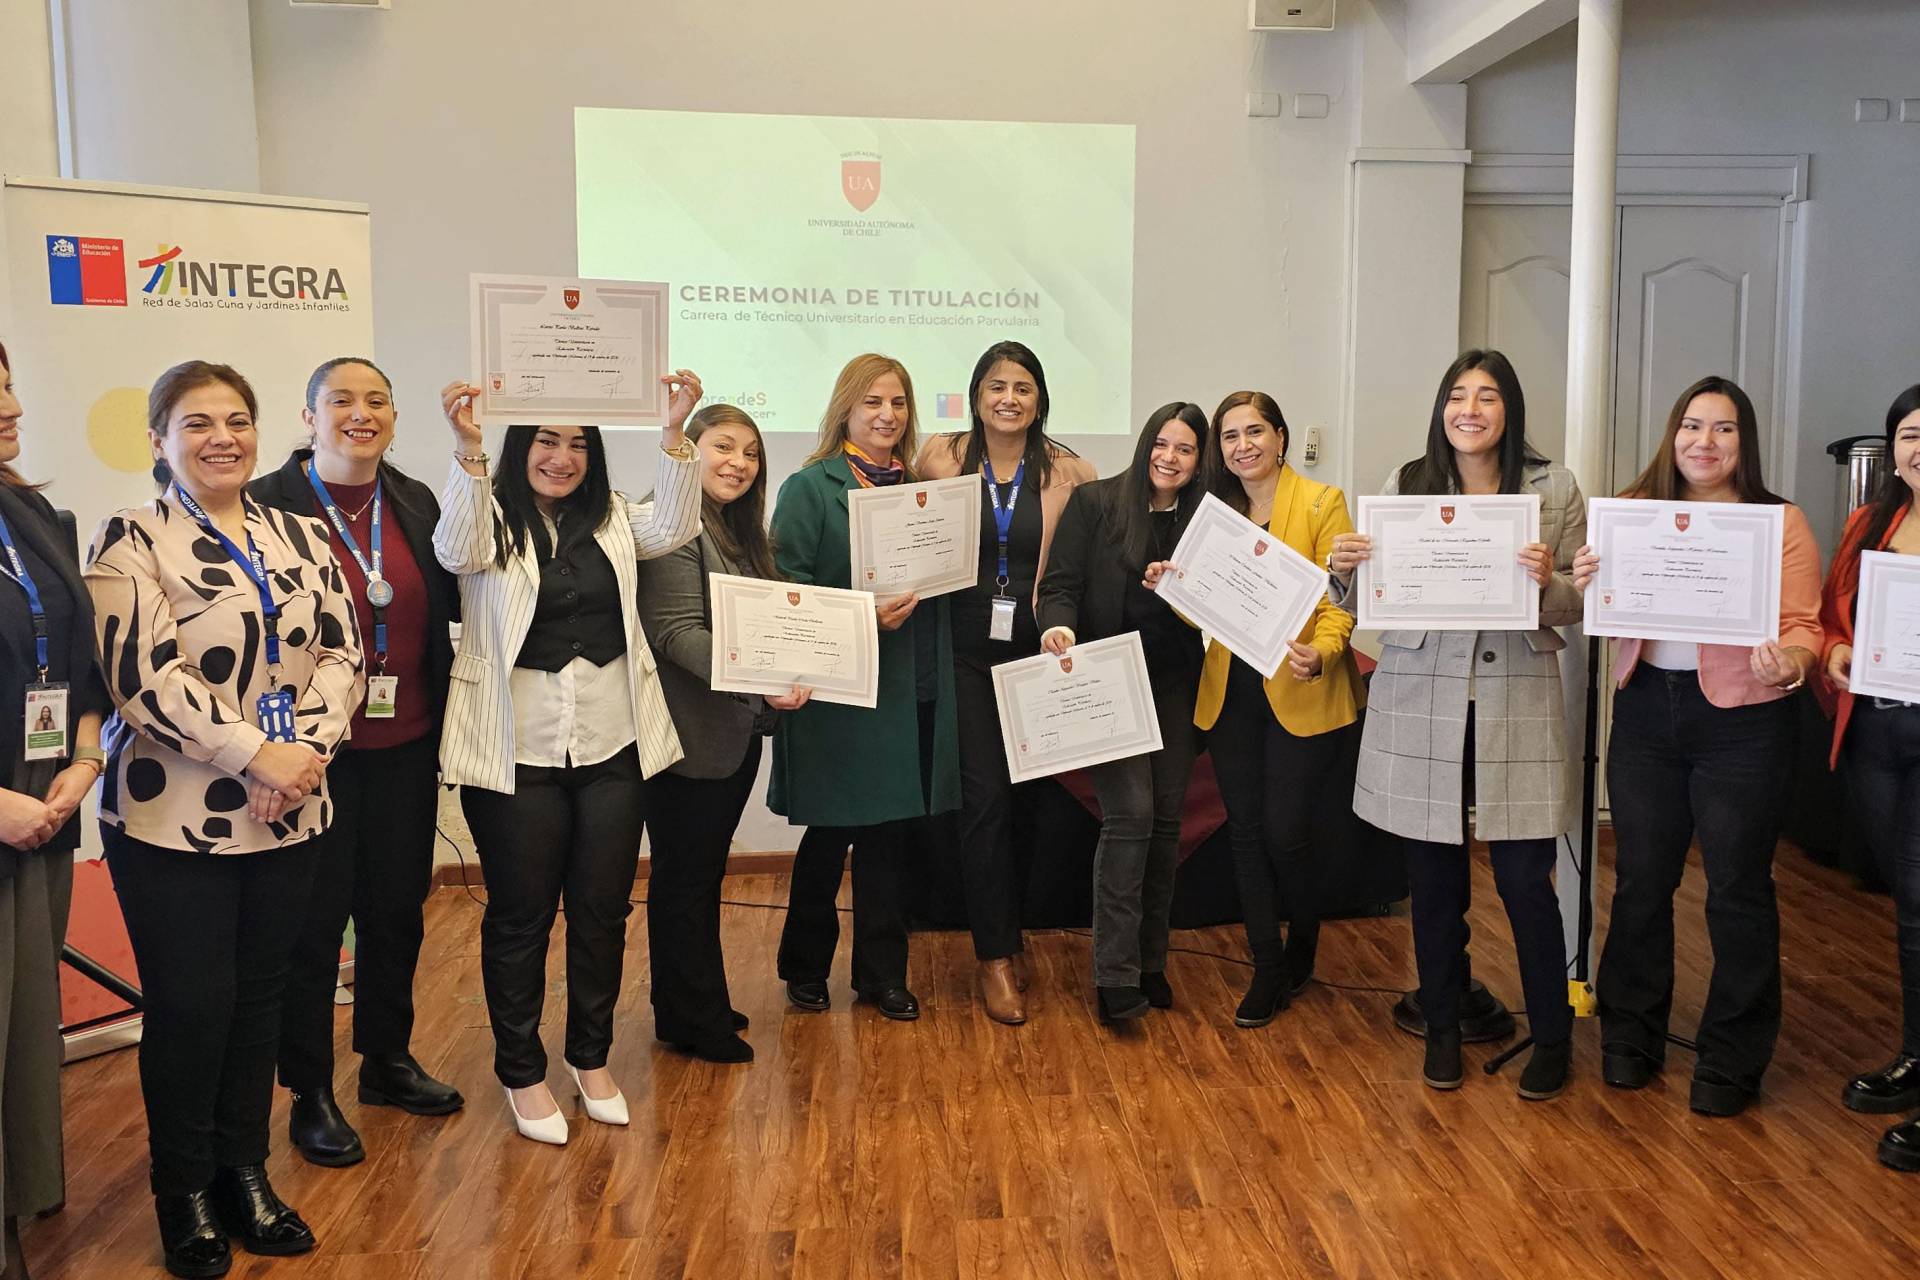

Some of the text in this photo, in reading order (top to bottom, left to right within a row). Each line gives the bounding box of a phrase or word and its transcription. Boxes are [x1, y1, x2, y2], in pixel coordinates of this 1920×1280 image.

[848, 175, 875, 191] UA
[807, 219, 865, 229] UNIVERSIDAD
[842, 228, 881, 237] DE CHILE
[178, 261, 348, 300] INTEGRA
[143, 297, 350, 312] Red de Salas Cuna y Jardines Infantiles
[680, 285, 1039, 309] CEREMONIA DE TITULACIÓN
[680, 309, 1039, 327] Carrera de Técnico Universitario en Educación Parvularia
